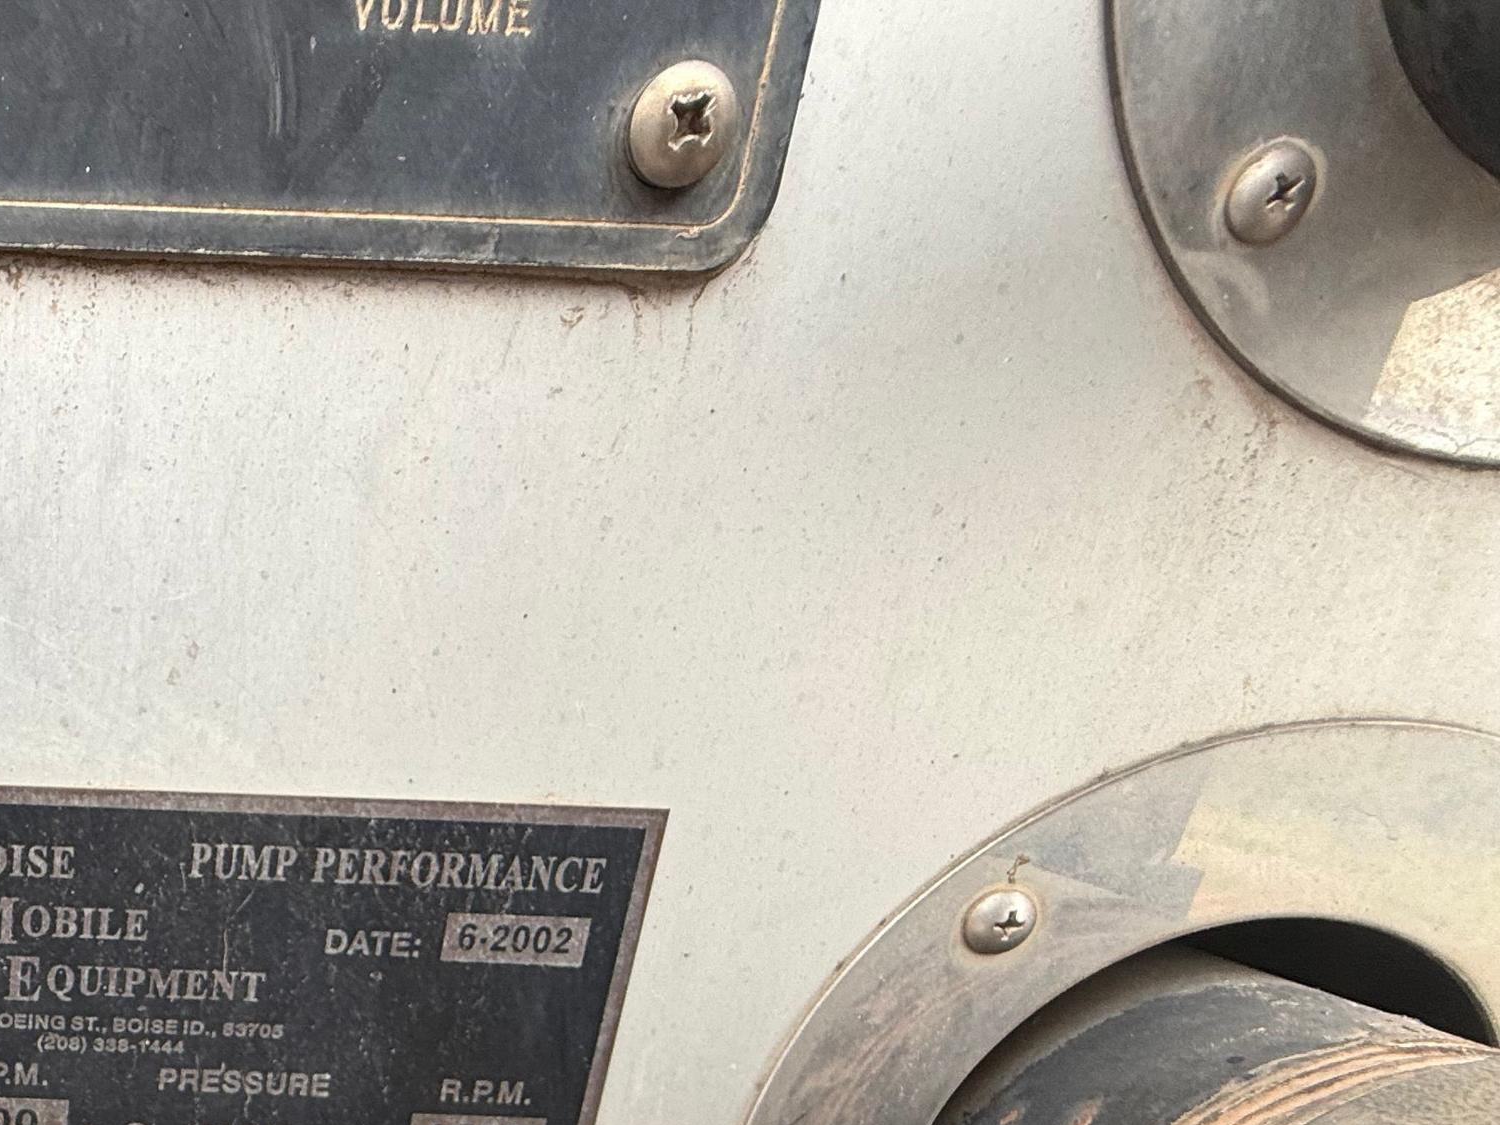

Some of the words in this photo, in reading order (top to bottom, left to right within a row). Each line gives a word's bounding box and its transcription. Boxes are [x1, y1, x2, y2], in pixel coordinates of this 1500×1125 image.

[355, 0, 531, 36] VOLUME
[190, 842, 297, 882] PUMP
[311, 846, 607, 894] PERFORMANCE
[324, 928, 421, 958] DATE:
[4, 955, 266, 1003] EQUIPMENT
[70, 1015, 107, 1034] ST.,
[112, 1016, 178, 1035] BOISE
[37, 1033, 87, 1054] (208)
[157, 1068, 331, 1098] PRESSURE
[439, 1078, 532, 1106] R.P.M.
